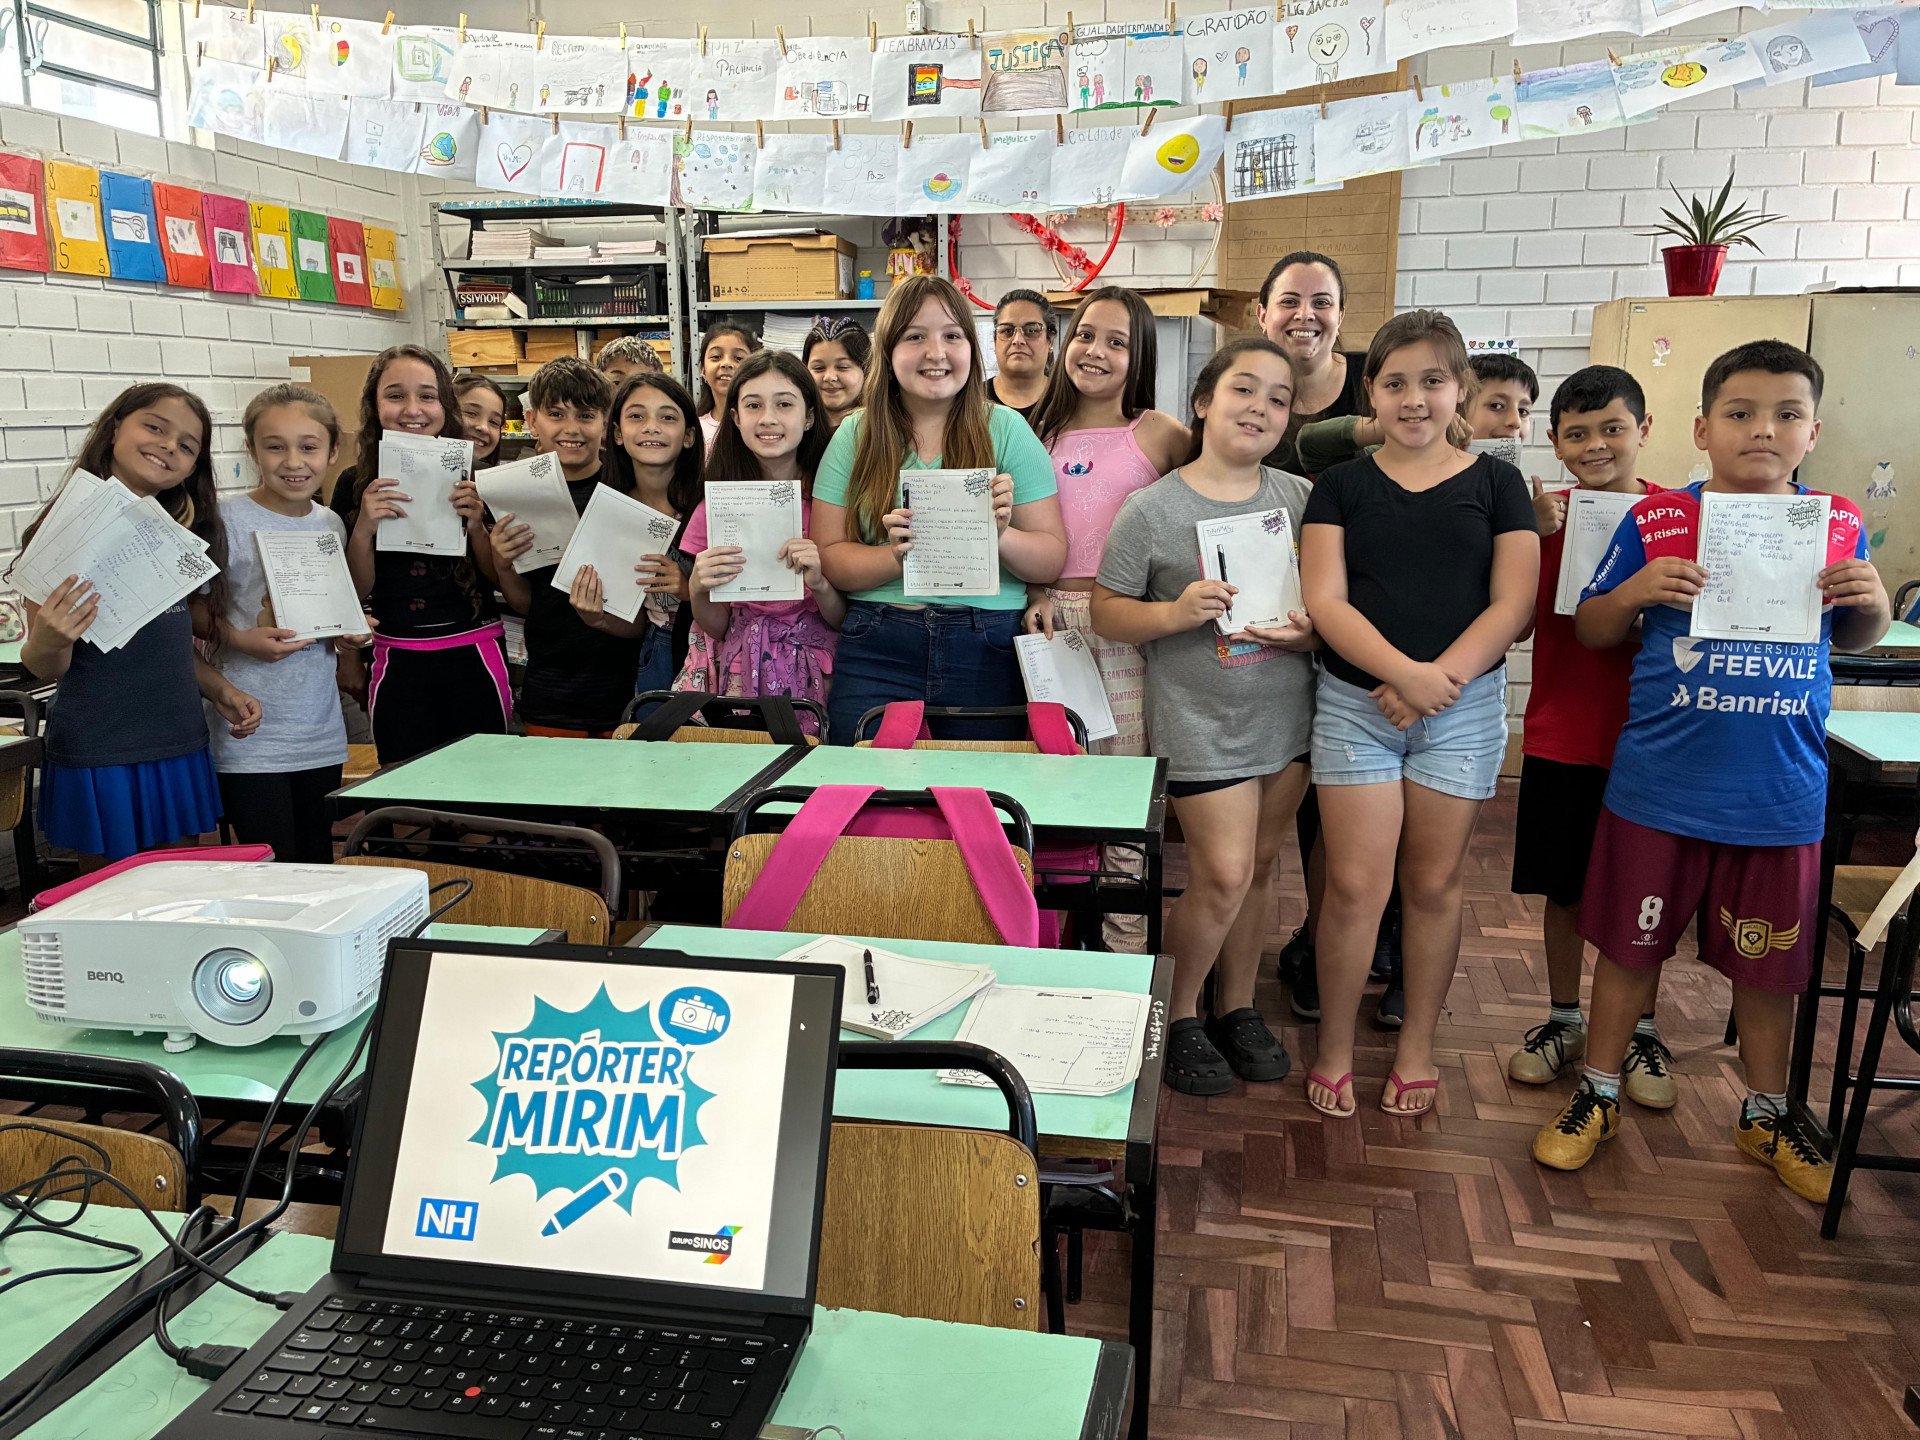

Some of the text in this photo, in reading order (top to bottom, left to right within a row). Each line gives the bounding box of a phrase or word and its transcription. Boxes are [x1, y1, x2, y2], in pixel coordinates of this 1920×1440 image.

[1127, 24, 1171, 34] IRMANDAD
[1186, 9, 1267, 37] GRATIDÃO
[882, 36, 956, 54] LEMBRANSAS
[460, 293, 500, 303] HOUAISS
[1647, 507, 1686, 524] APTA
[1791, 511, 1816, 521] MIRIM
[1829, 509, 1860, 529] APTA
[1654, 526, 1689, 541] Rissul
[1710, 641, 1820, 657] UNIVERSIDADE
[1708, 654, 1818, 680] FEEVALE
[1696, 686, 1810, 716] Banrisul
[1637, 895, 1664, 931] 8
[87, 970, 125, 984] BenQ
[502, 1032, 684, 1086] REPÓRTER
[491, 1088, 684, 1154] MIRIM
[422, 1202, 473, 1237] NH
[671, 1236, 730, 1251] GRUPO SINOS
